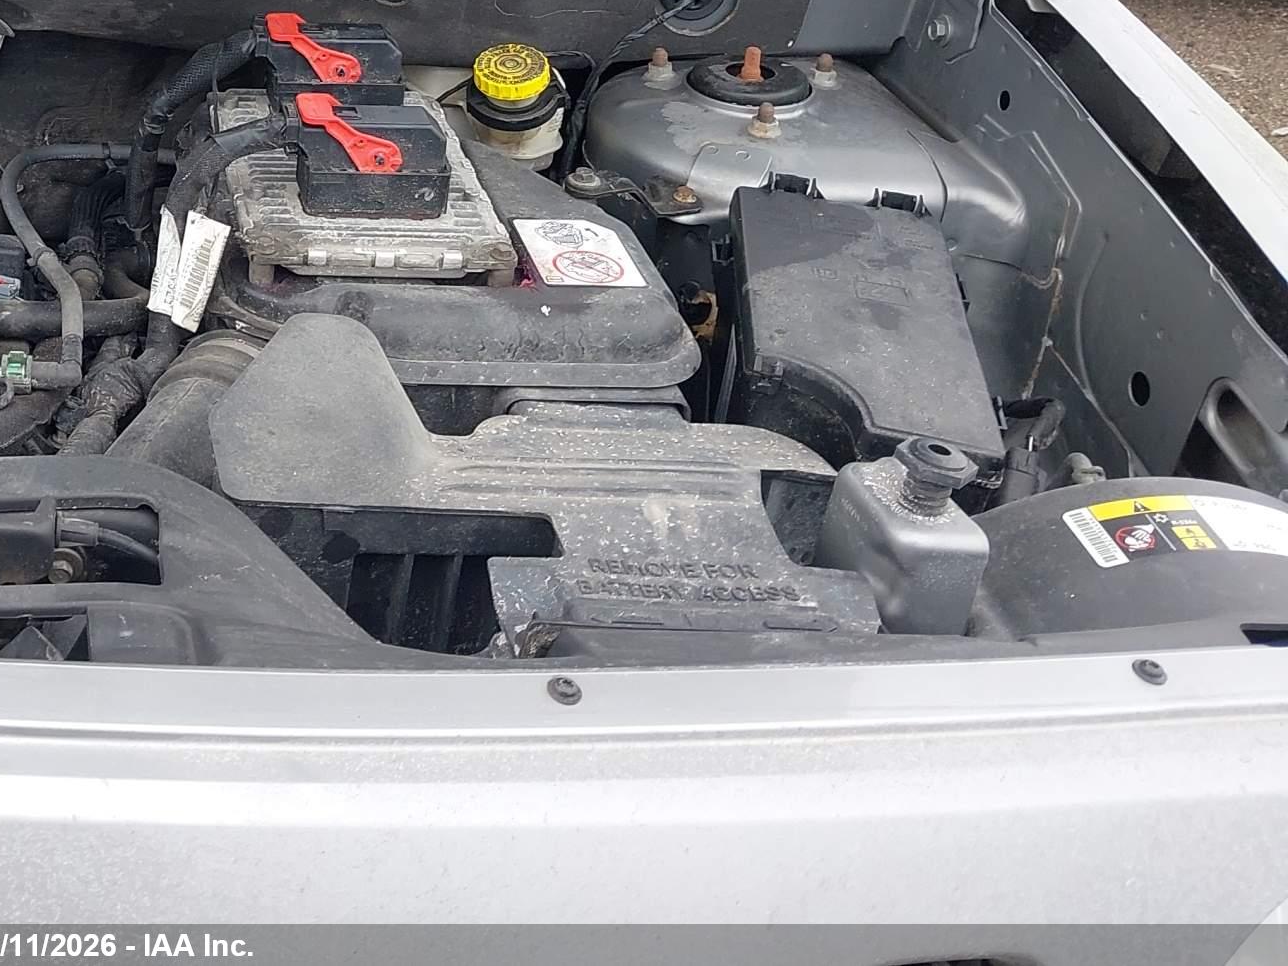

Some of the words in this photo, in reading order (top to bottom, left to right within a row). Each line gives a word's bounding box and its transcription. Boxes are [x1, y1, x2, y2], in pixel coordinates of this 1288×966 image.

[587, 557, 700, 580] REMOVE
[703, 563, 760, 580] FOR
[577, 580, 686, 601] BATTERY
[697, 585, 802, 603] ACCESS
